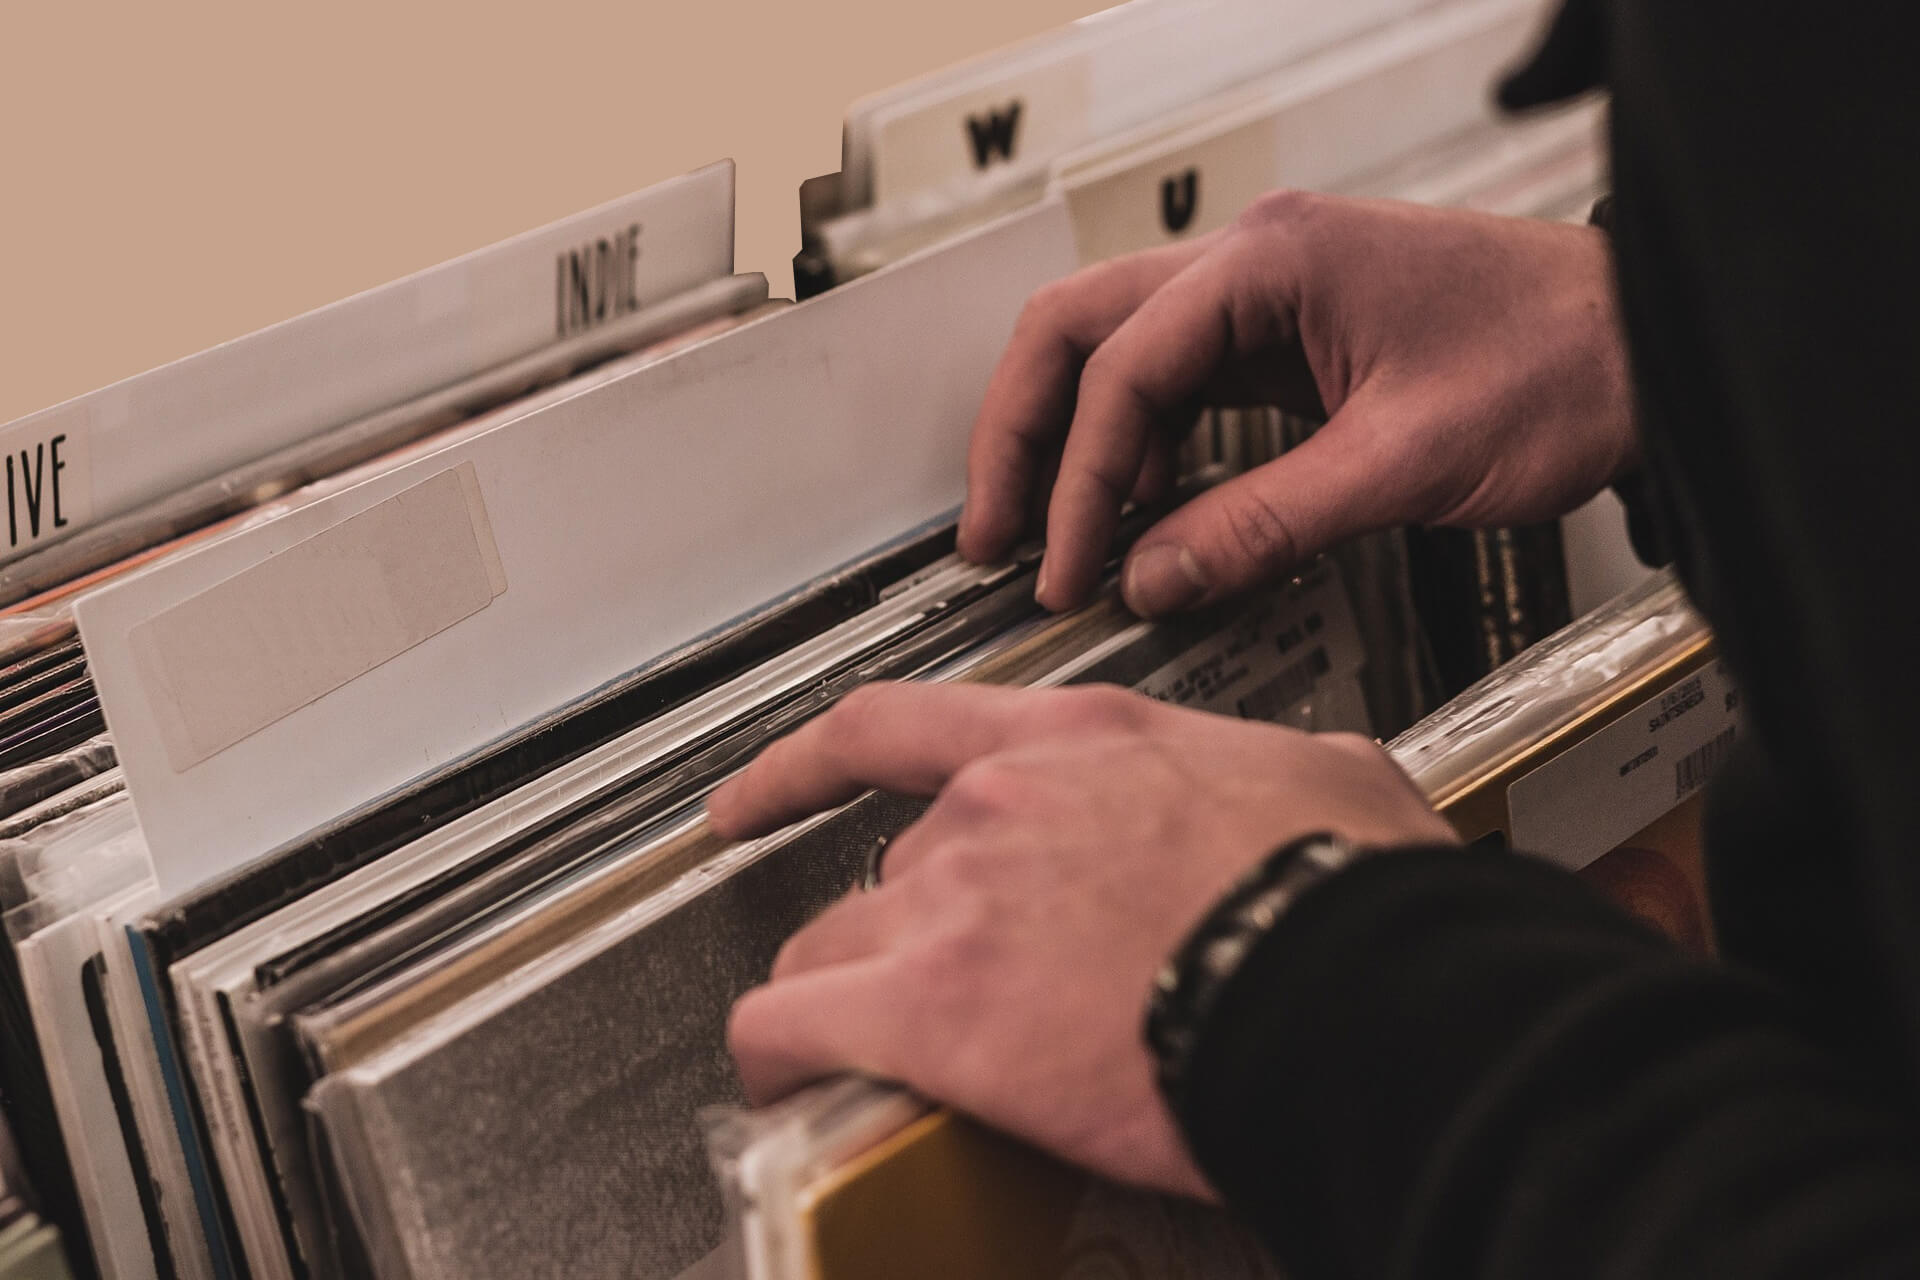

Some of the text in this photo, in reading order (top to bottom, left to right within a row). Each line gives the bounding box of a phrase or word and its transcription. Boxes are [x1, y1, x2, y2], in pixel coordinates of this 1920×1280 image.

[966, 99, 1023, 171] W
[1160, 166, 1199, 235] U
[556, 223, 642, 338] INDIE
[6, 433, 67, 547] IVE
